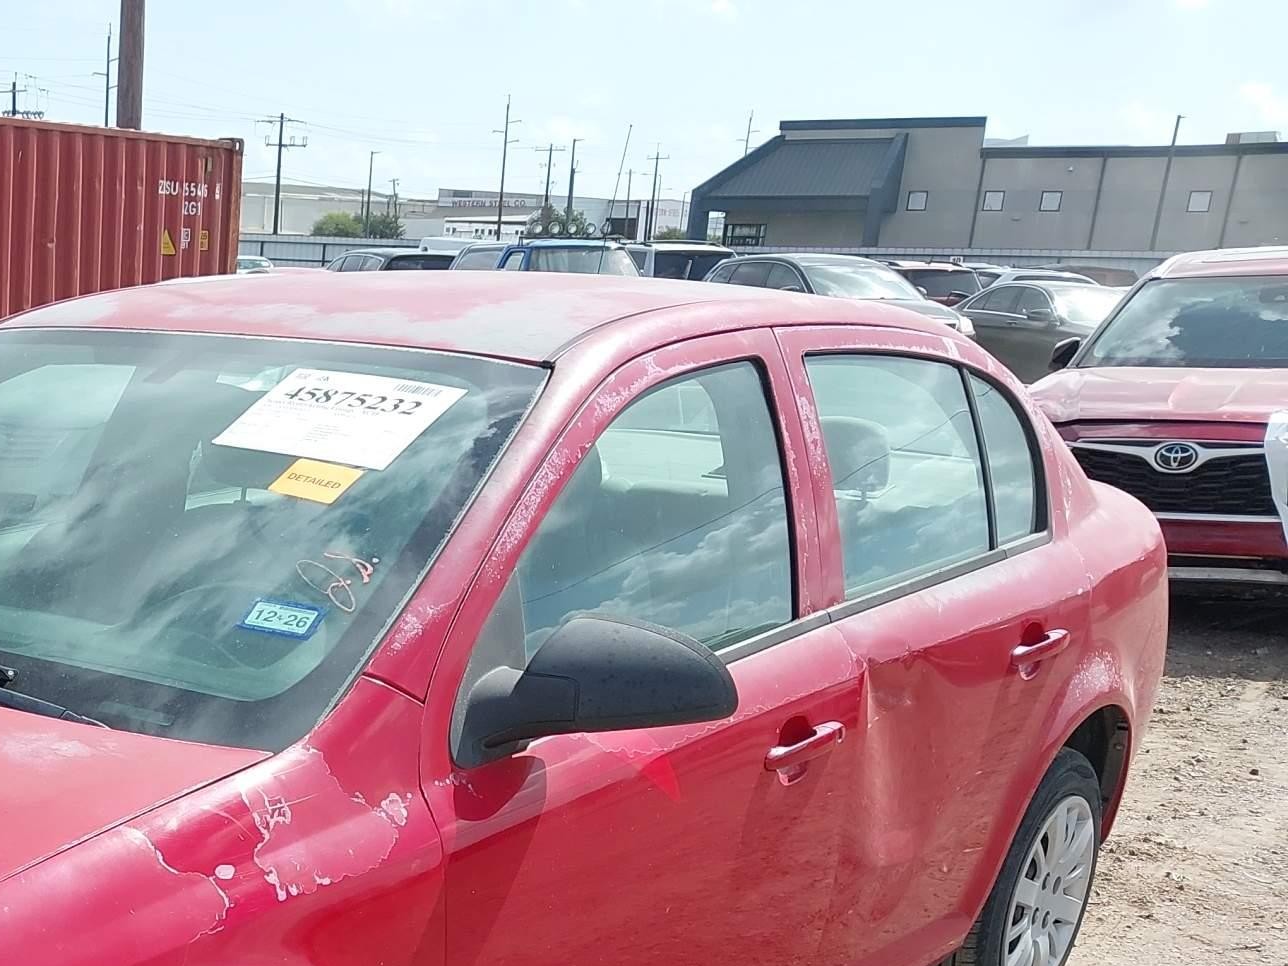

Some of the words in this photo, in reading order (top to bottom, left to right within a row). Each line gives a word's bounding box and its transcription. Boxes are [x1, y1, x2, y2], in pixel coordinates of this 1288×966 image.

[451, 199, 486, 208] WESTERN
[488, 199, 511, 208] STEL
[284, 385, 423, 416] 45875232
[287, 472, 343, 490] DETAILED
